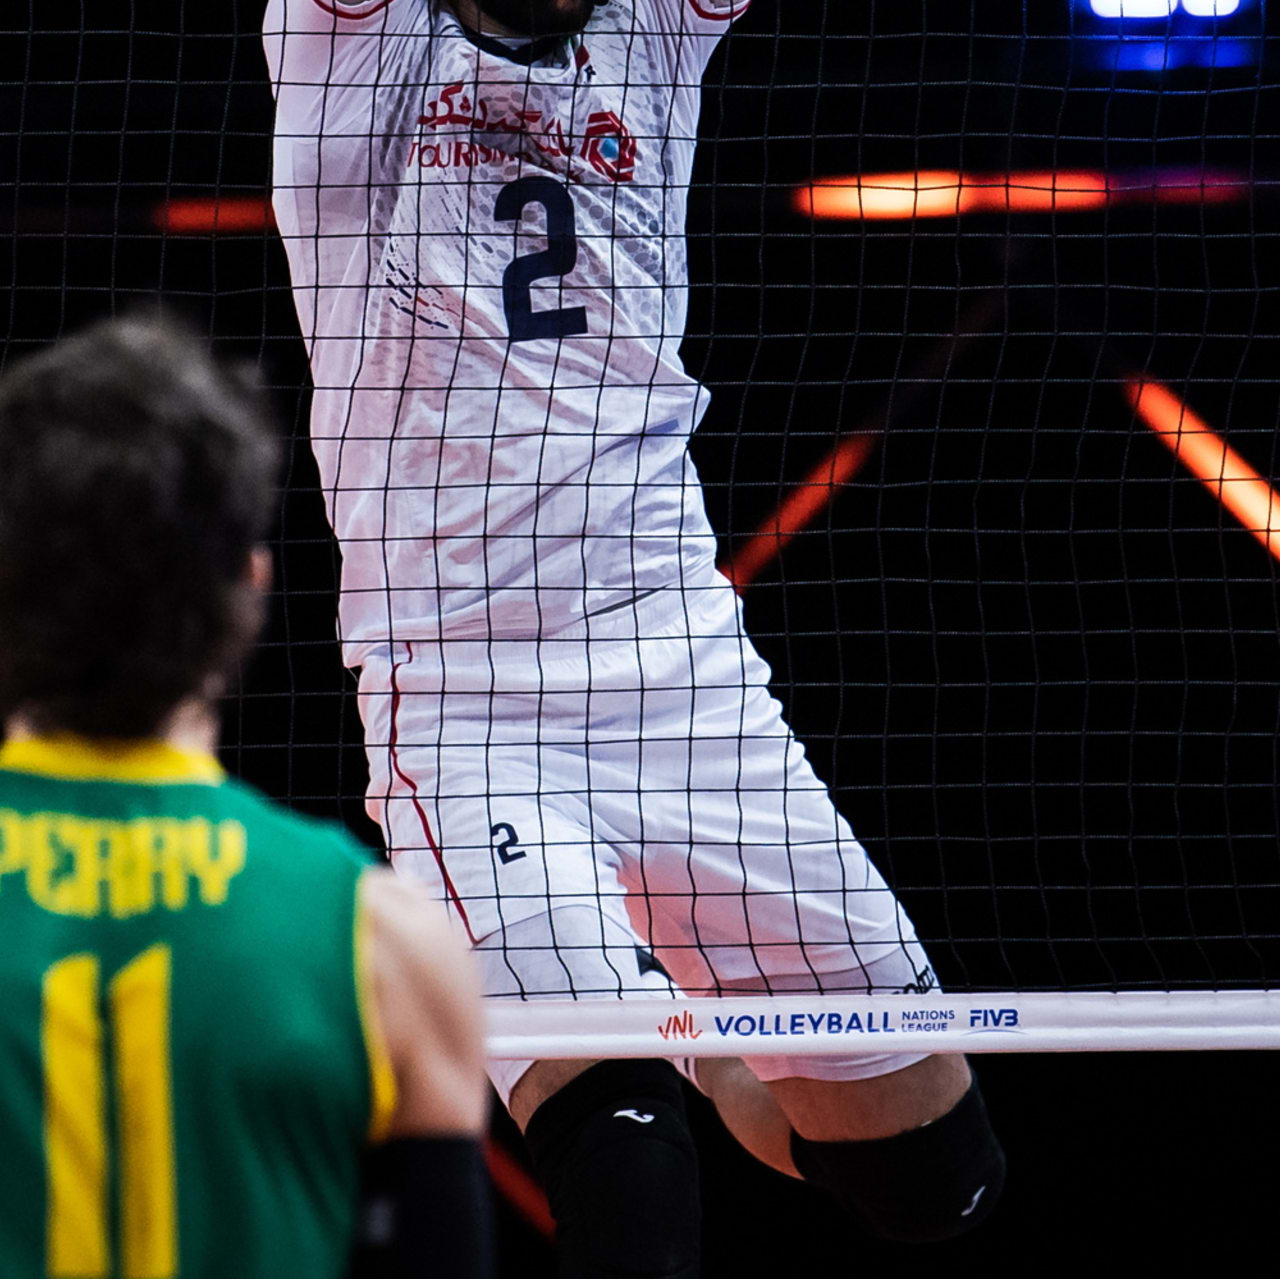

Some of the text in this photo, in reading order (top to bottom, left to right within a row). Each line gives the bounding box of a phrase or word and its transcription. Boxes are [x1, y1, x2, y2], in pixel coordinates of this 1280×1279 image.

[494, 176, 588, 343] 2
[491, 822, 527, 865] 2
[658, 1010, 956, 1040] VNL VOLLEYBALL NATIONS
[901, 1022, 949, 1033] LEAGUE
[969, 1008, 1019, 1028] FIVB
[41, 941, 179, 1279] 11
